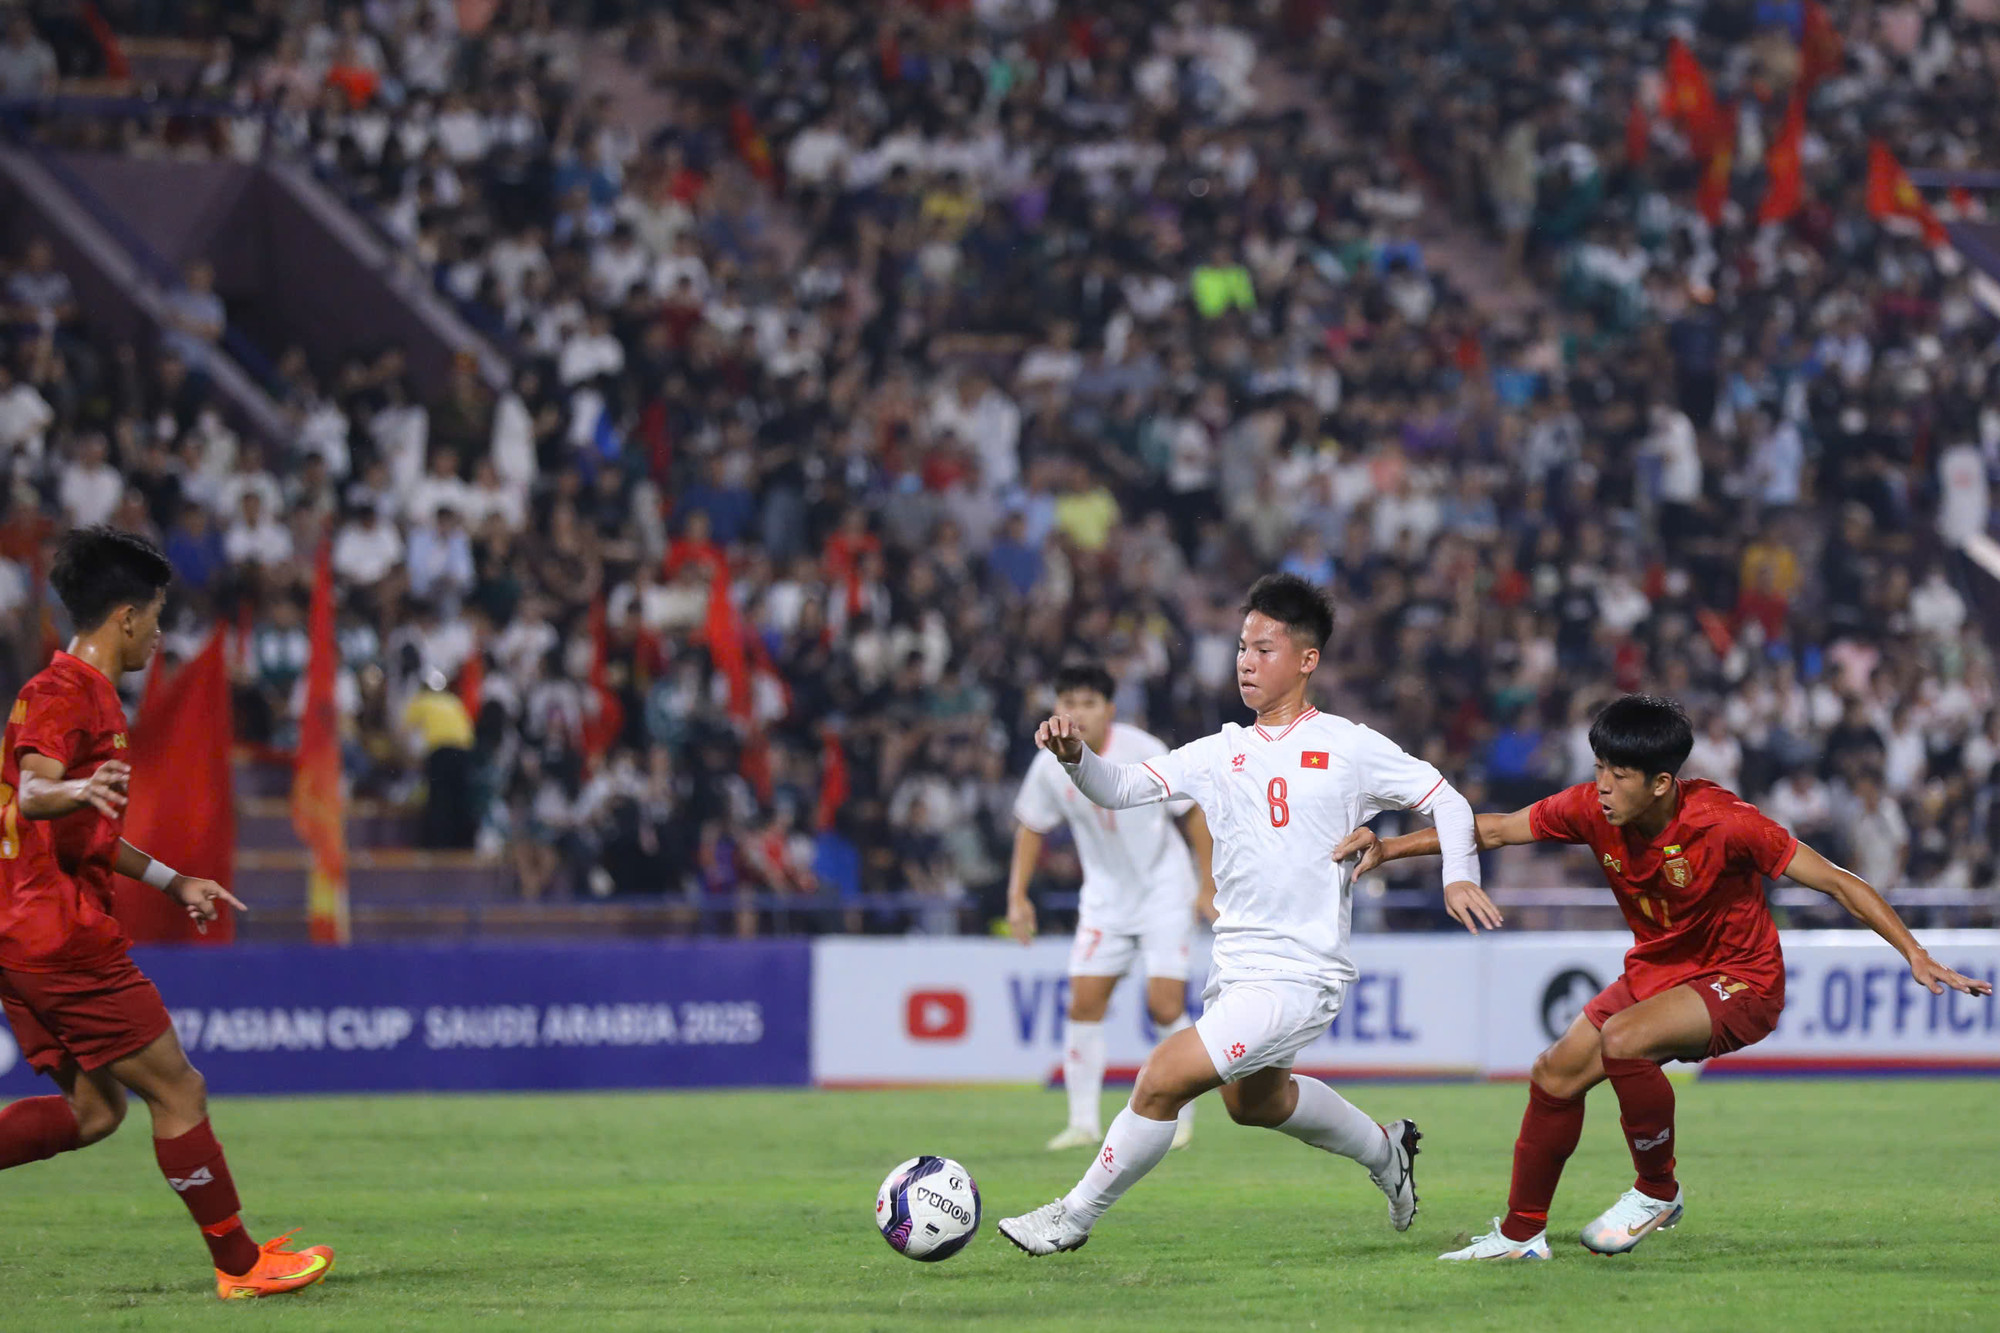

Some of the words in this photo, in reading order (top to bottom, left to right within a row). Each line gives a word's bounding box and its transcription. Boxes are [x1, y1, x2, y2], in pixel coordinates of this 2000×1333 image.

[1267, 776, 1290, 828] 8
[203, 1007, 326, 1050] ASIAN
[327, 1006, 413, 1050] CUP
[425, 1006, 539, 1049] SAUDI
[541, 1003, 679, 1046] ARABIA
[917, 1187, 971, 1225] COBRA
